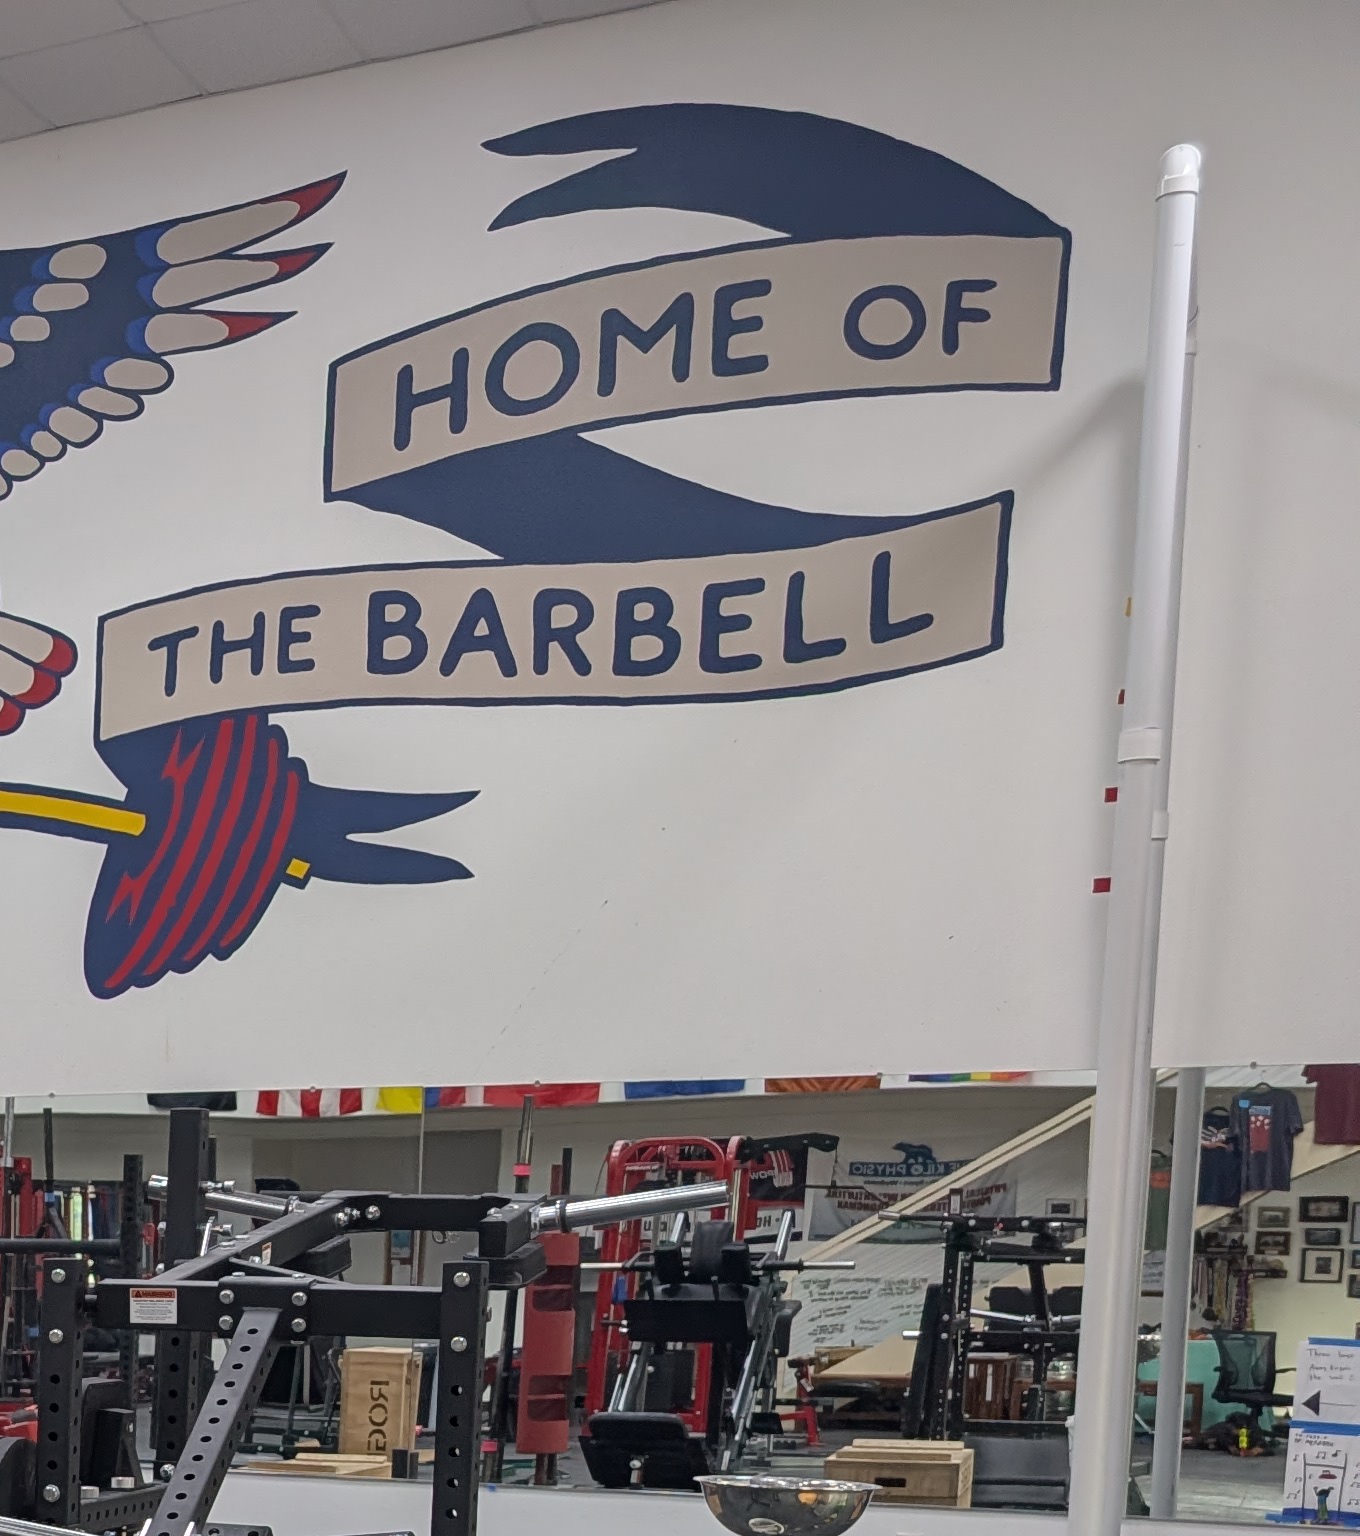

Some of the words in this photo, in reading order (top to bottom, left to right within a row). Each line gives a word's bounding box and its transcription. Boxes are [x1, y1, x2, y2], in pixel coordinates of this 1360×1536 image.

[392, 279, 772, 451] HOME
[842, 279, 997, 360] OF
[147, 604, 321, 698] THE
[366, 551, 935, 678] BARBELL
